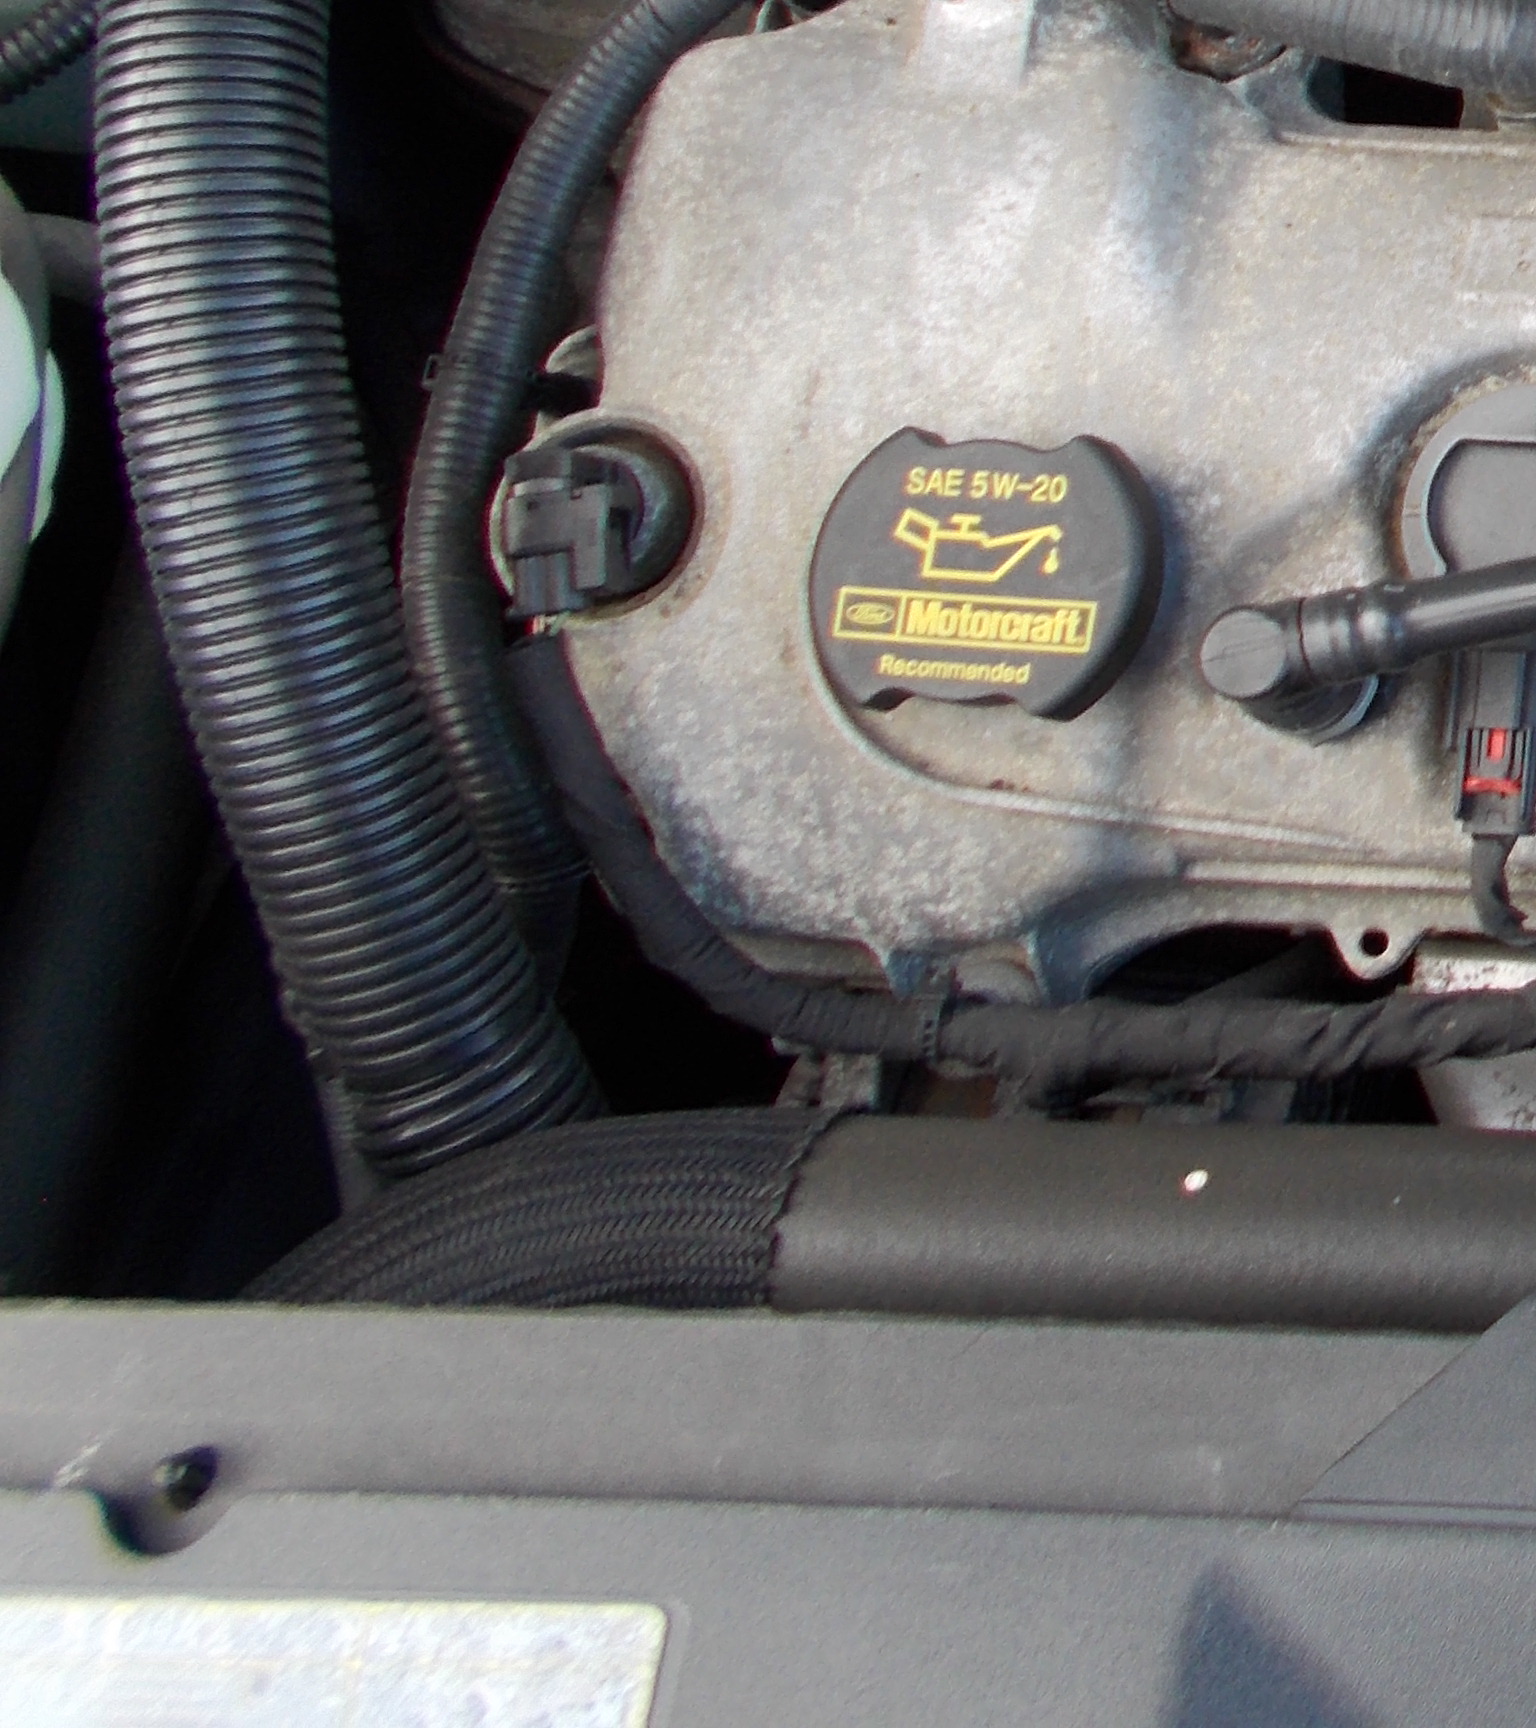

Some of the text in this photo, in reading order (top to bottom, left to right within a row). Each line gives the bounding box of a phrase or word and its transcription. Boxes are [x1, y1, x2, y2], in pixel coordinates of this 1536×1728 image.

[905, 466, 1068, 504] SAE 5W-20
[849, 598, 1084, 644] Ford Motorcraft
[878, 652, 1032, 685] Recommended
